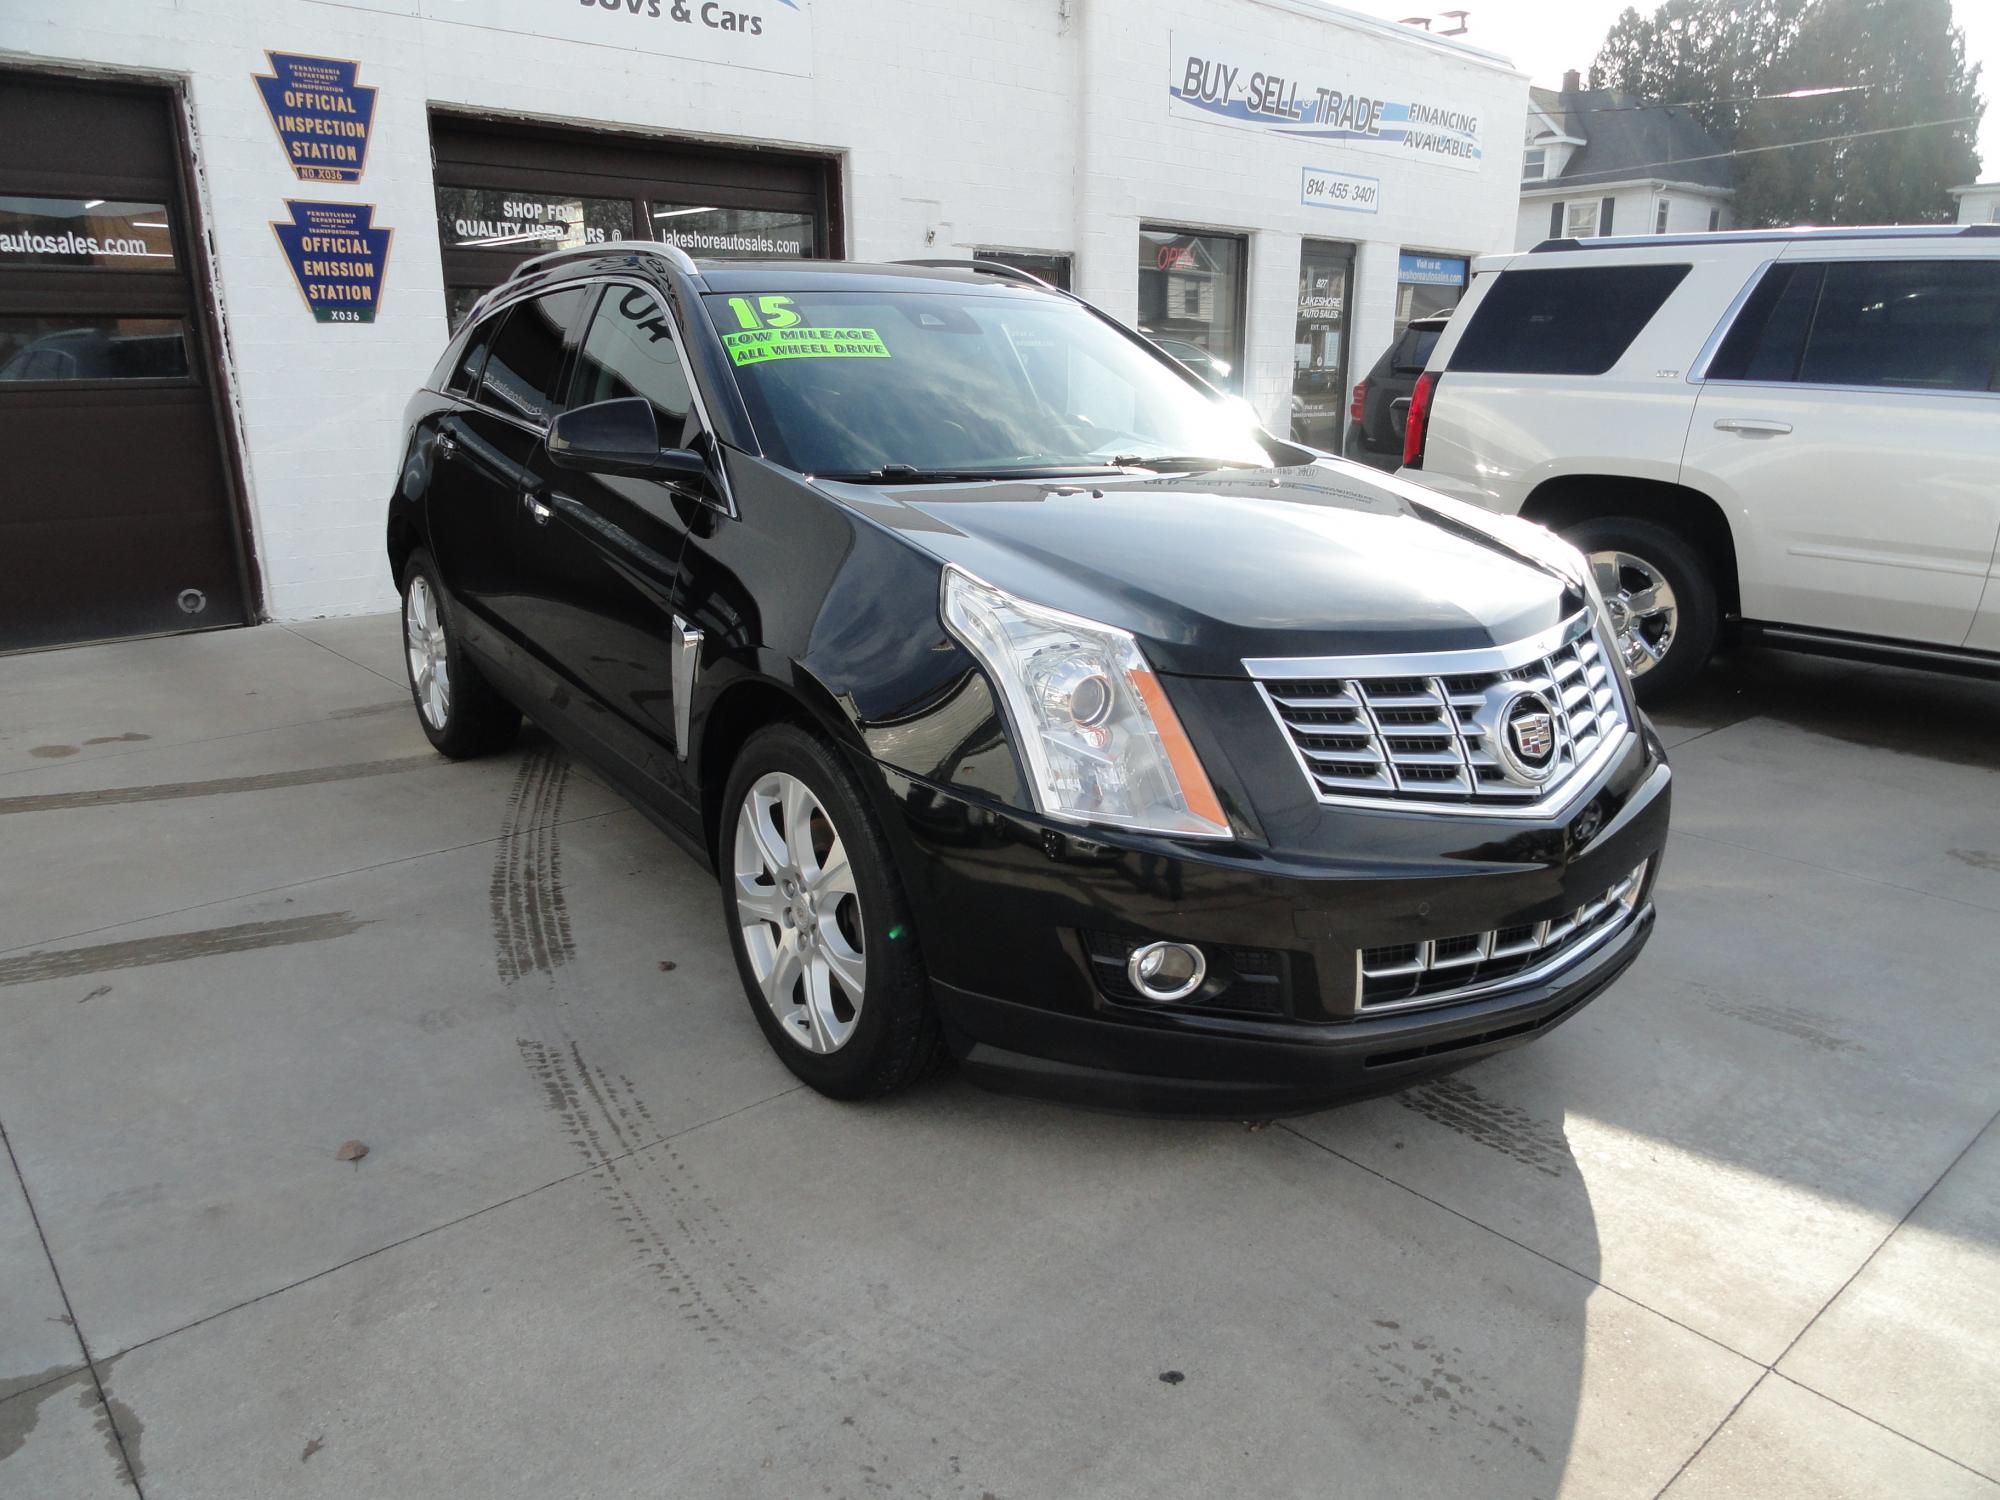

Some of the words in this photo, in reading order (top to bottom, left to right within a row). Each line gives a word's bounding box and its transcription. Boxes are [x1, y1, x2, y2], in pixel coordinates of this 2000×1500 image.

[670, 0, 692, 24] &
[700, 1, 762, 36] Cars
[284, 90, 357, 113] OFFICIAL
[1182, 56, 1239, 104] BUY
[1247, 72, 1301, 119] SELL
[1315, 87, 1384, 135] TRADE
[278, 115, 366, 138] INSPECTION
[1408, 102, 1477, 133] FINANCING
[291, 140, 357, 161] STATION
[1402, 130, 1474, 159] AVAILABLE
[317, 169, 343, 180] X036
[1306, 178, 1325, 196] 814
[1328, 181, 1350, 200] 455
[1351, 185, 1376, 203] 3401
[503, 201, 543, 219] SHOP
[455, 219, 521, 238] QUALITY
[526, 223, 564, 241] USED
[662, 228, 800, 254] lakeshoreautosales.com
[0, 230, 147, 255] autosales.com
[302, 236, 372, 255] OFFICIAL
[303, 260, 374, 278] EMISSION
[309, 284, 372, 300] STATION
[1300, 295, 1342, 308] LAKESHORE
[331, 310, 360, 321] X036
[728, 296, 800, 329] 15
[727, 330, 772, 348] LOW
[779, 329, 876, 341] MILEAGE
[736, 346, 768, 362] ALL
[771, 343, 831, 356] WHEEL
[834, 344, 887, 355] DRIVE
